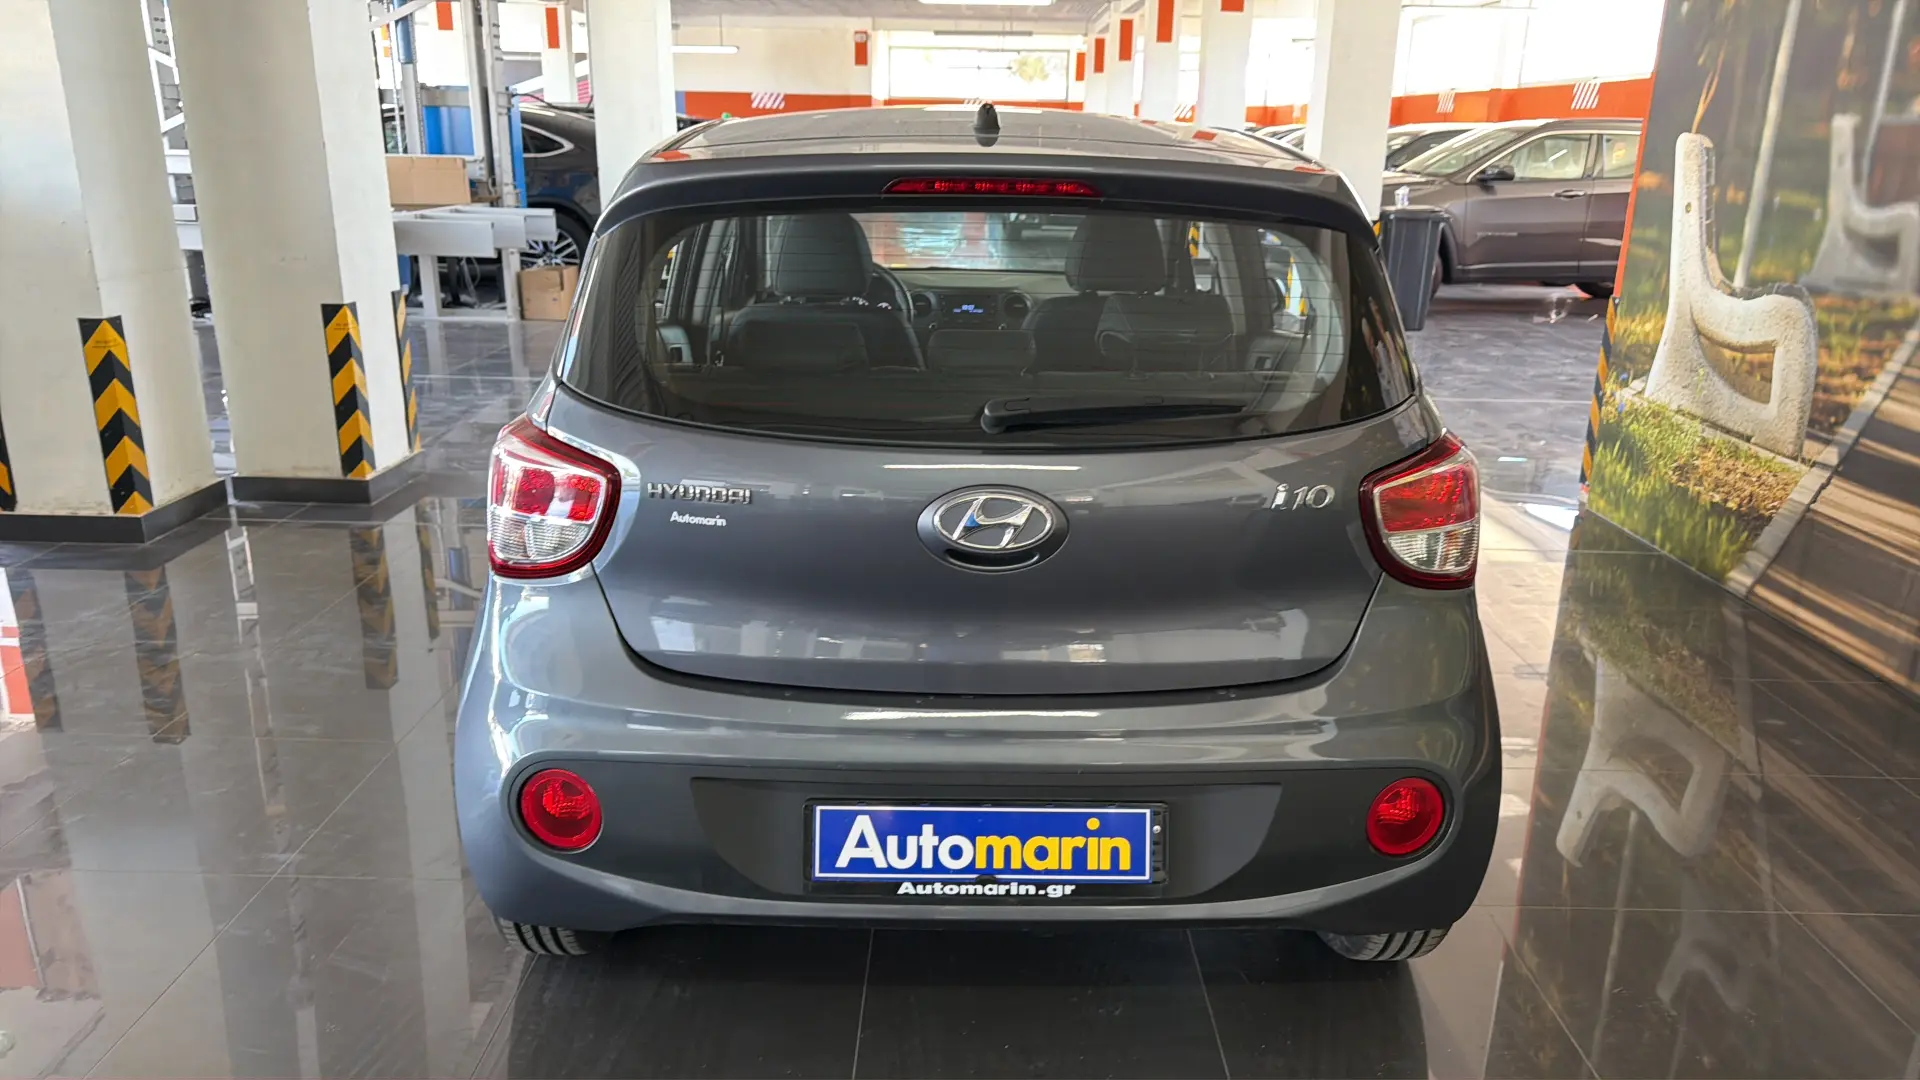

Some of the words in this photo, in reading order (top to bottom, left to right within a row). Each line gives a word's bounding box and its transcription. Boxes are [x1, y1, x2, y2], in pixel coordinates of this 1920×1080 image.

[647, 482, 752, 504] HYUNDAI
[1271, 483, 1336, 511] i10
[669, 511, 727, 527] Automarin
[835, 814, 1132, 871] Automarin
[897, 881, 1077, 898] Automarin.gr
